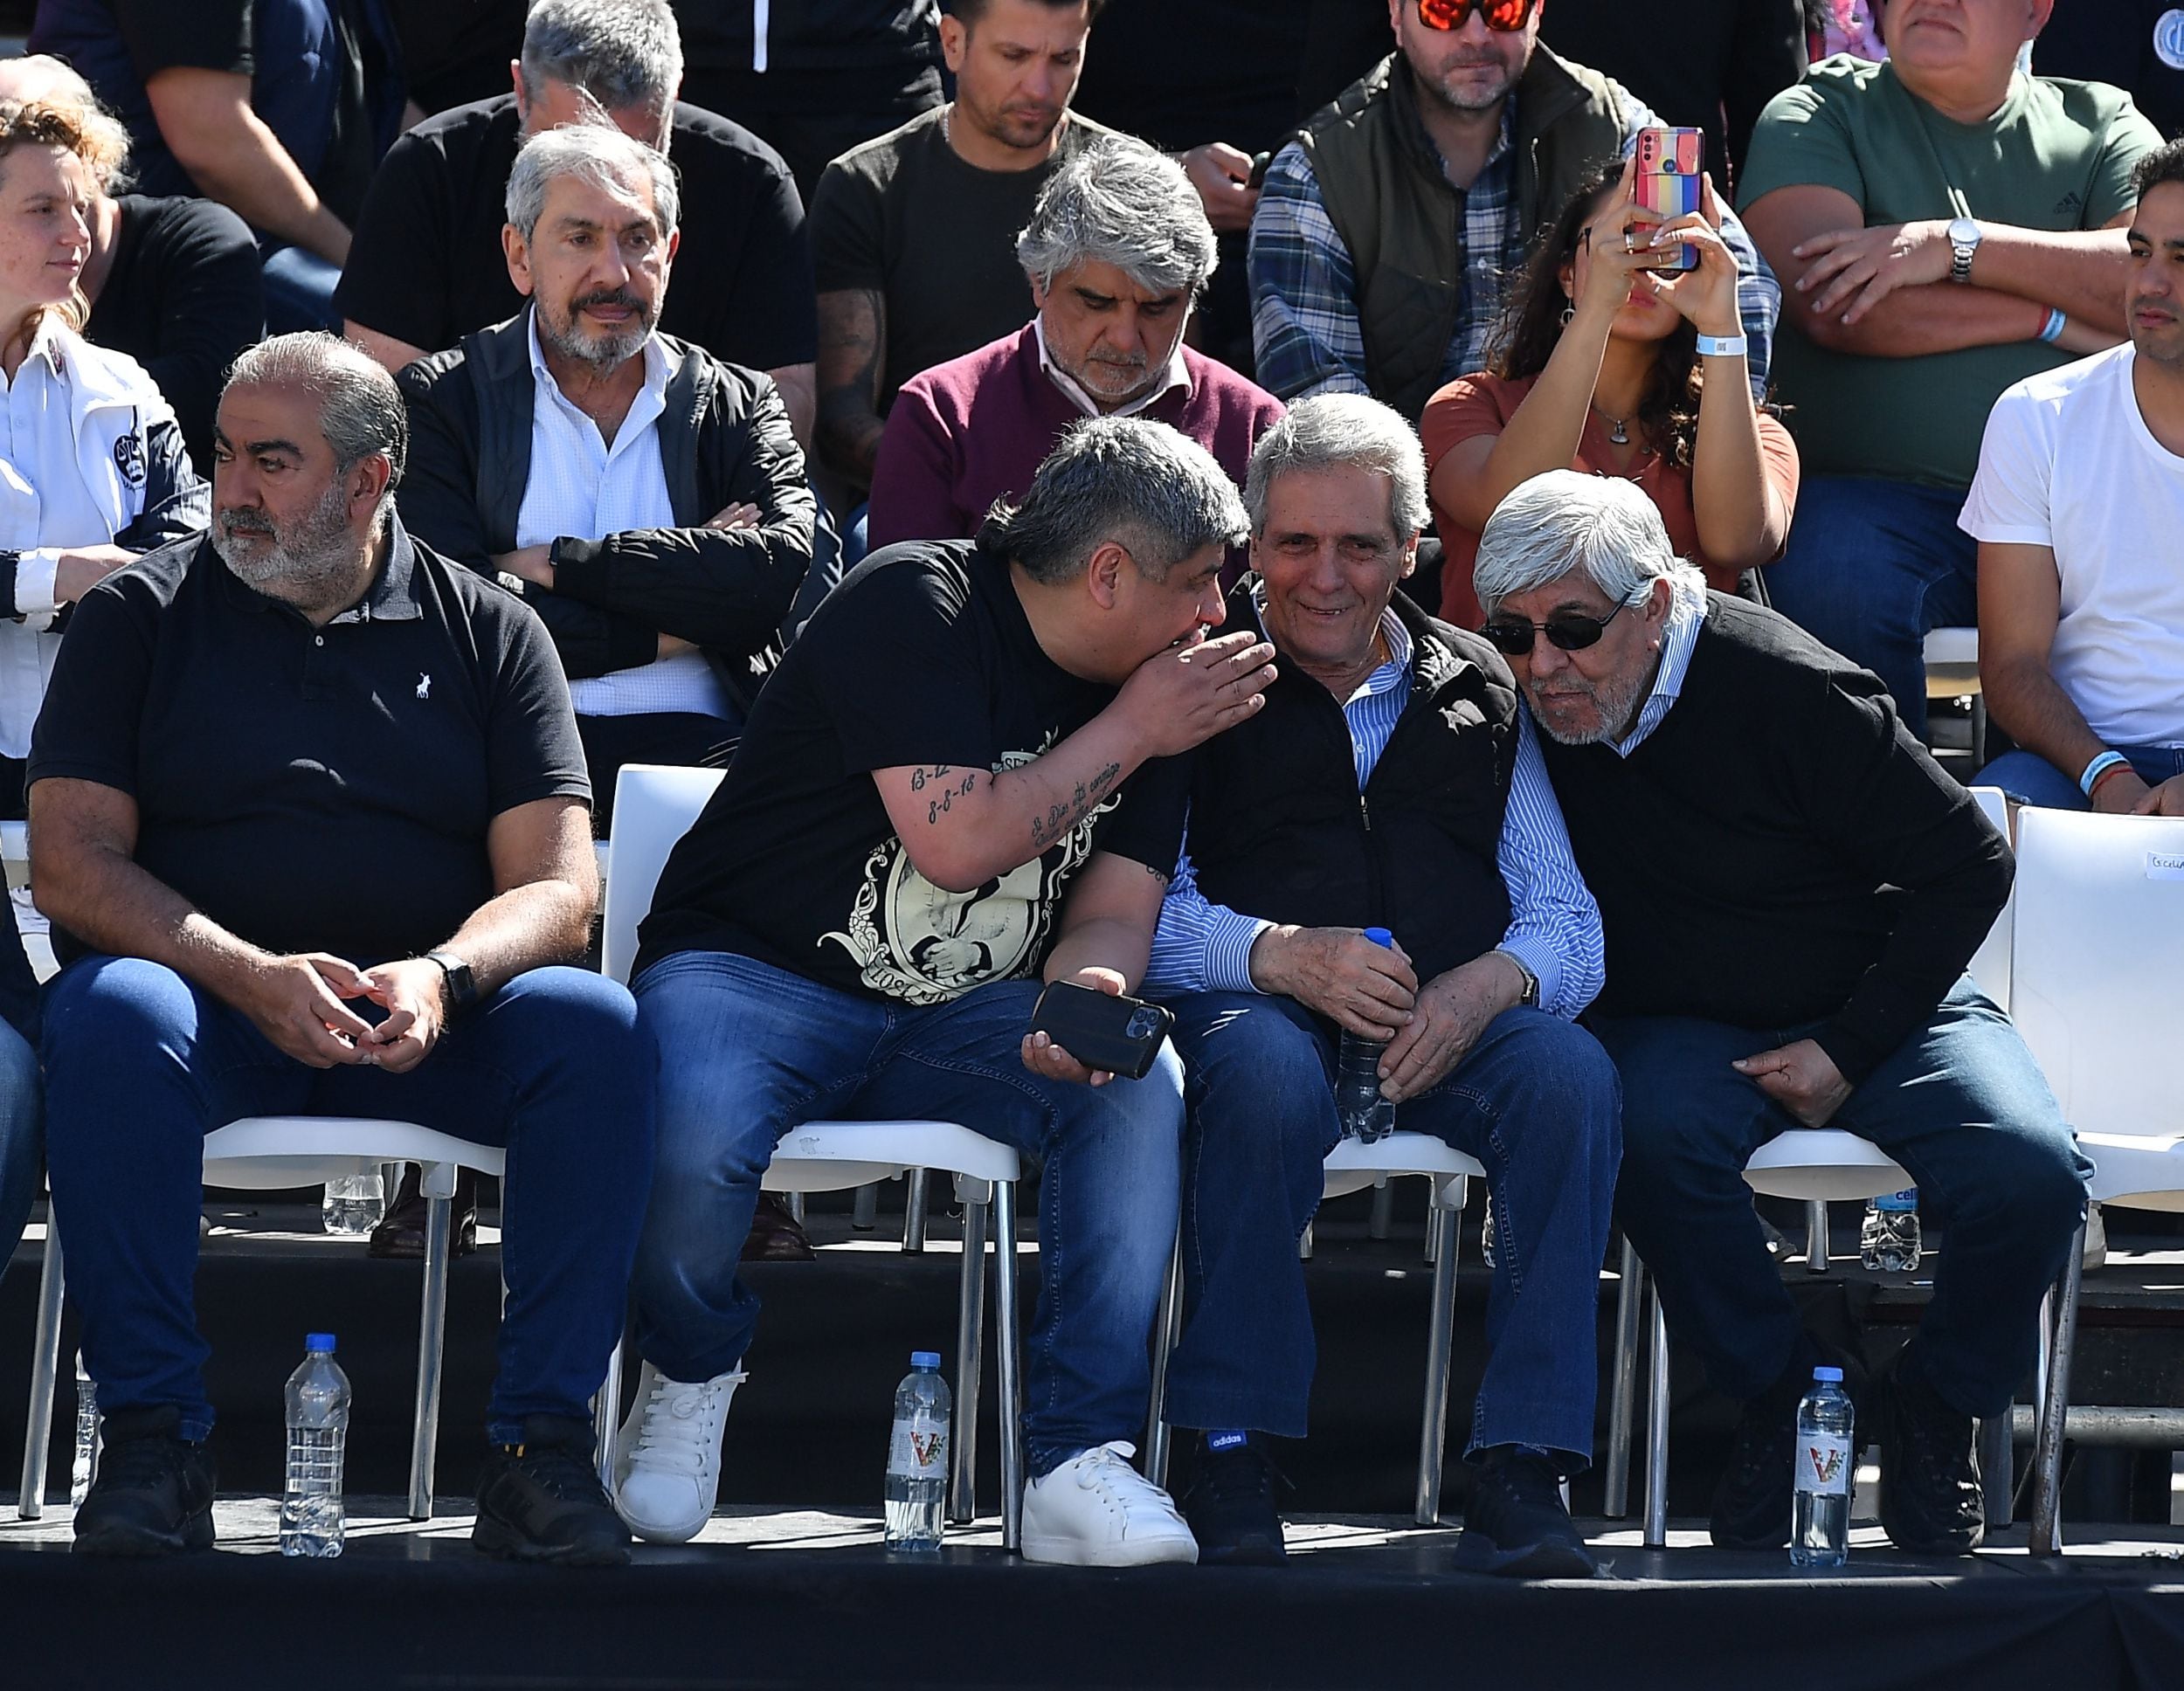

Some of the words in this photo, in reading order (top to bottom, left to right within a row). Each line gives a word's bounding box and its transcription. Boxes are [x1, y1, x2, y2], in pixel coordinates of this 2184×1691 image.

[929, 774, 975, 825] 8-8-18
[1048, 804, 1068, 827] Dios
[1213, 1435, 1241, 1447] adidas
